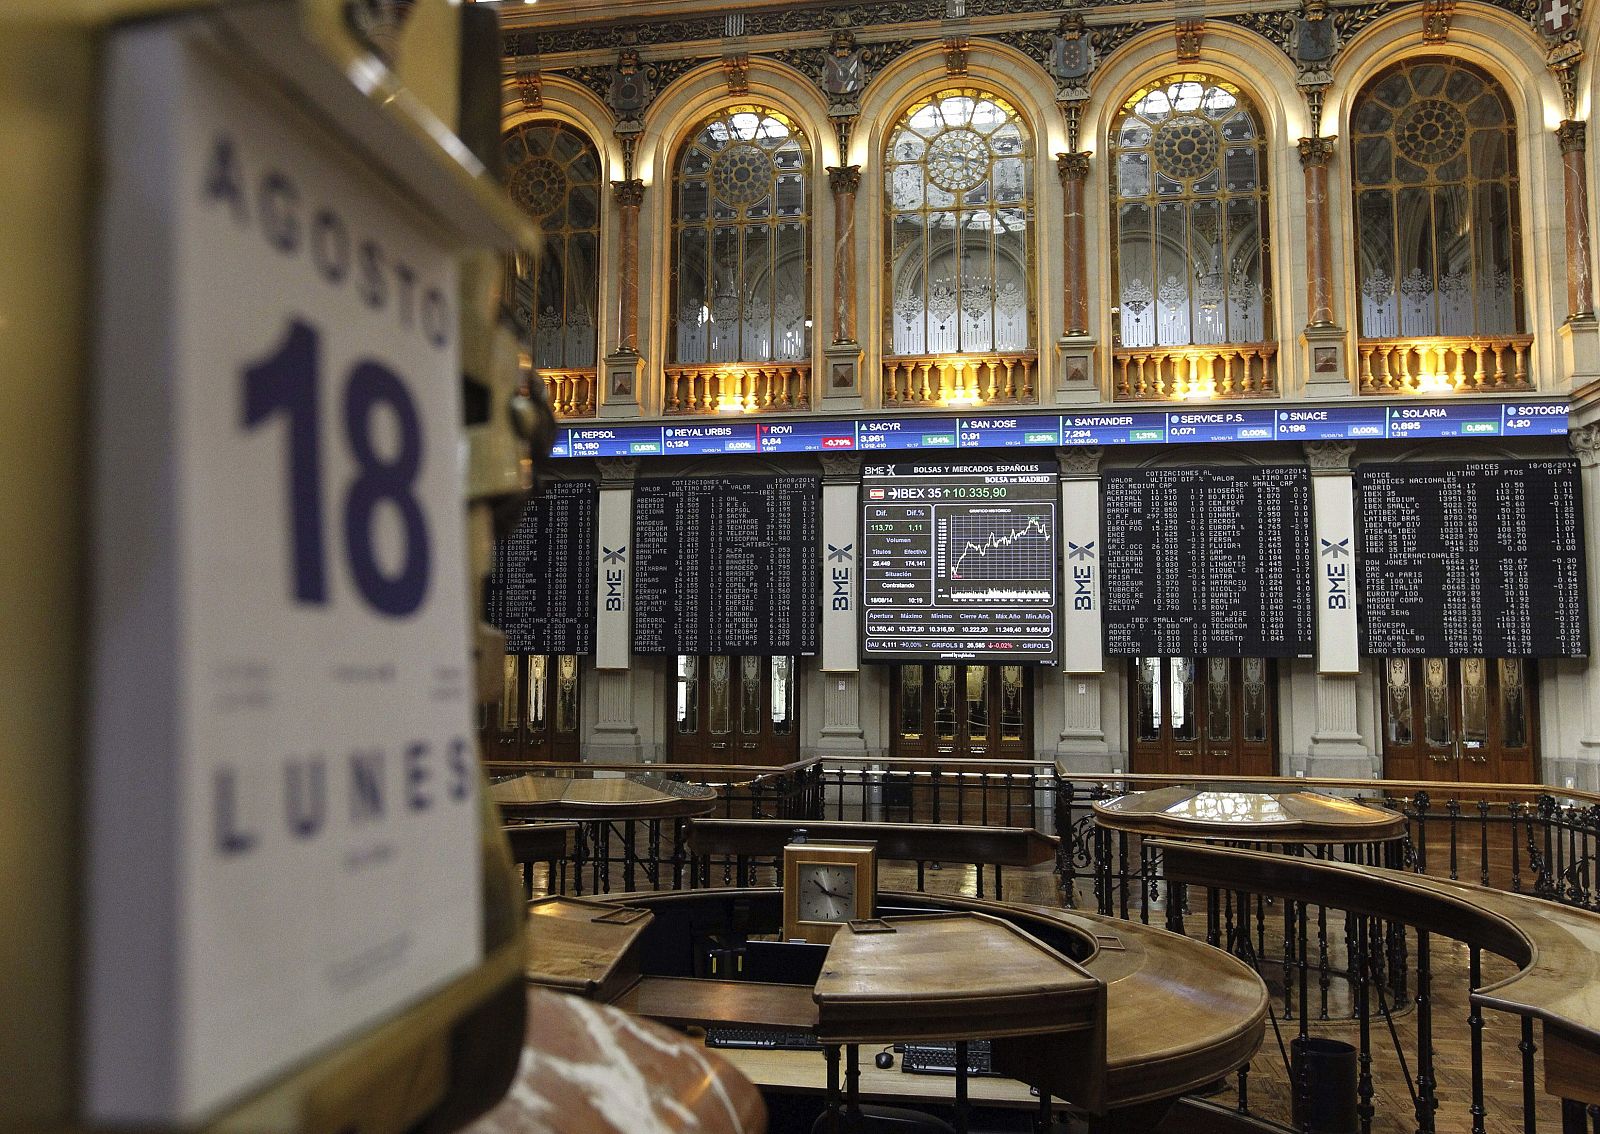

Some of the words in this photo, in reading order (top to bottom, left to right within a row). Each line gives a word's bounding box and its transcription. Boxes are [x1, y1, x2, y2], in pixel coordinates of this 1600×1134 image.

[202, 130, 450, 349] AGOSTO
[1289, 411, 1328, 421] SNIACE
[1402, 408, 1447, 418] SOLARIA
[1074, 416, 1133, 427] SANTANDER
[1180, 414, 1224, 424] SERVICE
[1226, 413, 1245, 423] P.S.
[869, 422, 901, 431] SACYR
[970, 420, 991, 429] SAN
[991, 419, 1017, 429] JOSE
[1506, 419, 1531, 429] 4,20
[674, 428, 704, 437] REYAL
[704, 427, 733, 436] URBIS
[770, 425, 793, 434] ROVI
[1064, 429, 1091, 440] 7,294
[1170, 427, 1196, 436] 0,071
[1352, 426, 1379, 434] 0,00%
[581, 430, 616, 440] REPSOL
[860, 434, 885, 444] 3,961
[960, 432, 980, 442] 0,91
[666, 440, 690, 449] 0,124
[761, 437, 782, 447] 8,84
[236, 313, 434, 623] 18
[864, 466, 885, 475] BME
[913, 466, 942, 474] BOLSAS
[951, 465, 994, 473] MERCADOS
[996, 463, 1039, 472] ESPAÑOLES
[1465, 463, 1500, 471] INDICES
[1145, 469, 1199, 477] COTIZACIONES
[984, 476, 1009, 484] BOLSA
[1018, 475, 1050, 483] MADRID
[897, 488, 925, 499] IBEX
[927, 488, 942, 498] 35
[952, 487, 1007, 499] 10.335,90
[875, 509, 888, 517] Dif.
[870, 524, 894, 532] 113,70
[908, 524, 923, 532] 1,11
[1389, 552, 1460, 560] INTERNACIONALES
[606, 569, 622, 612] BME
[832, 567, 849, 611] BME
[1074, 565, 1093, 611] BME
[1327, 563, 1346, 611] BME
[881, 641, 898, 649] 4,111
[212, 737, 469, 857] LUNES
